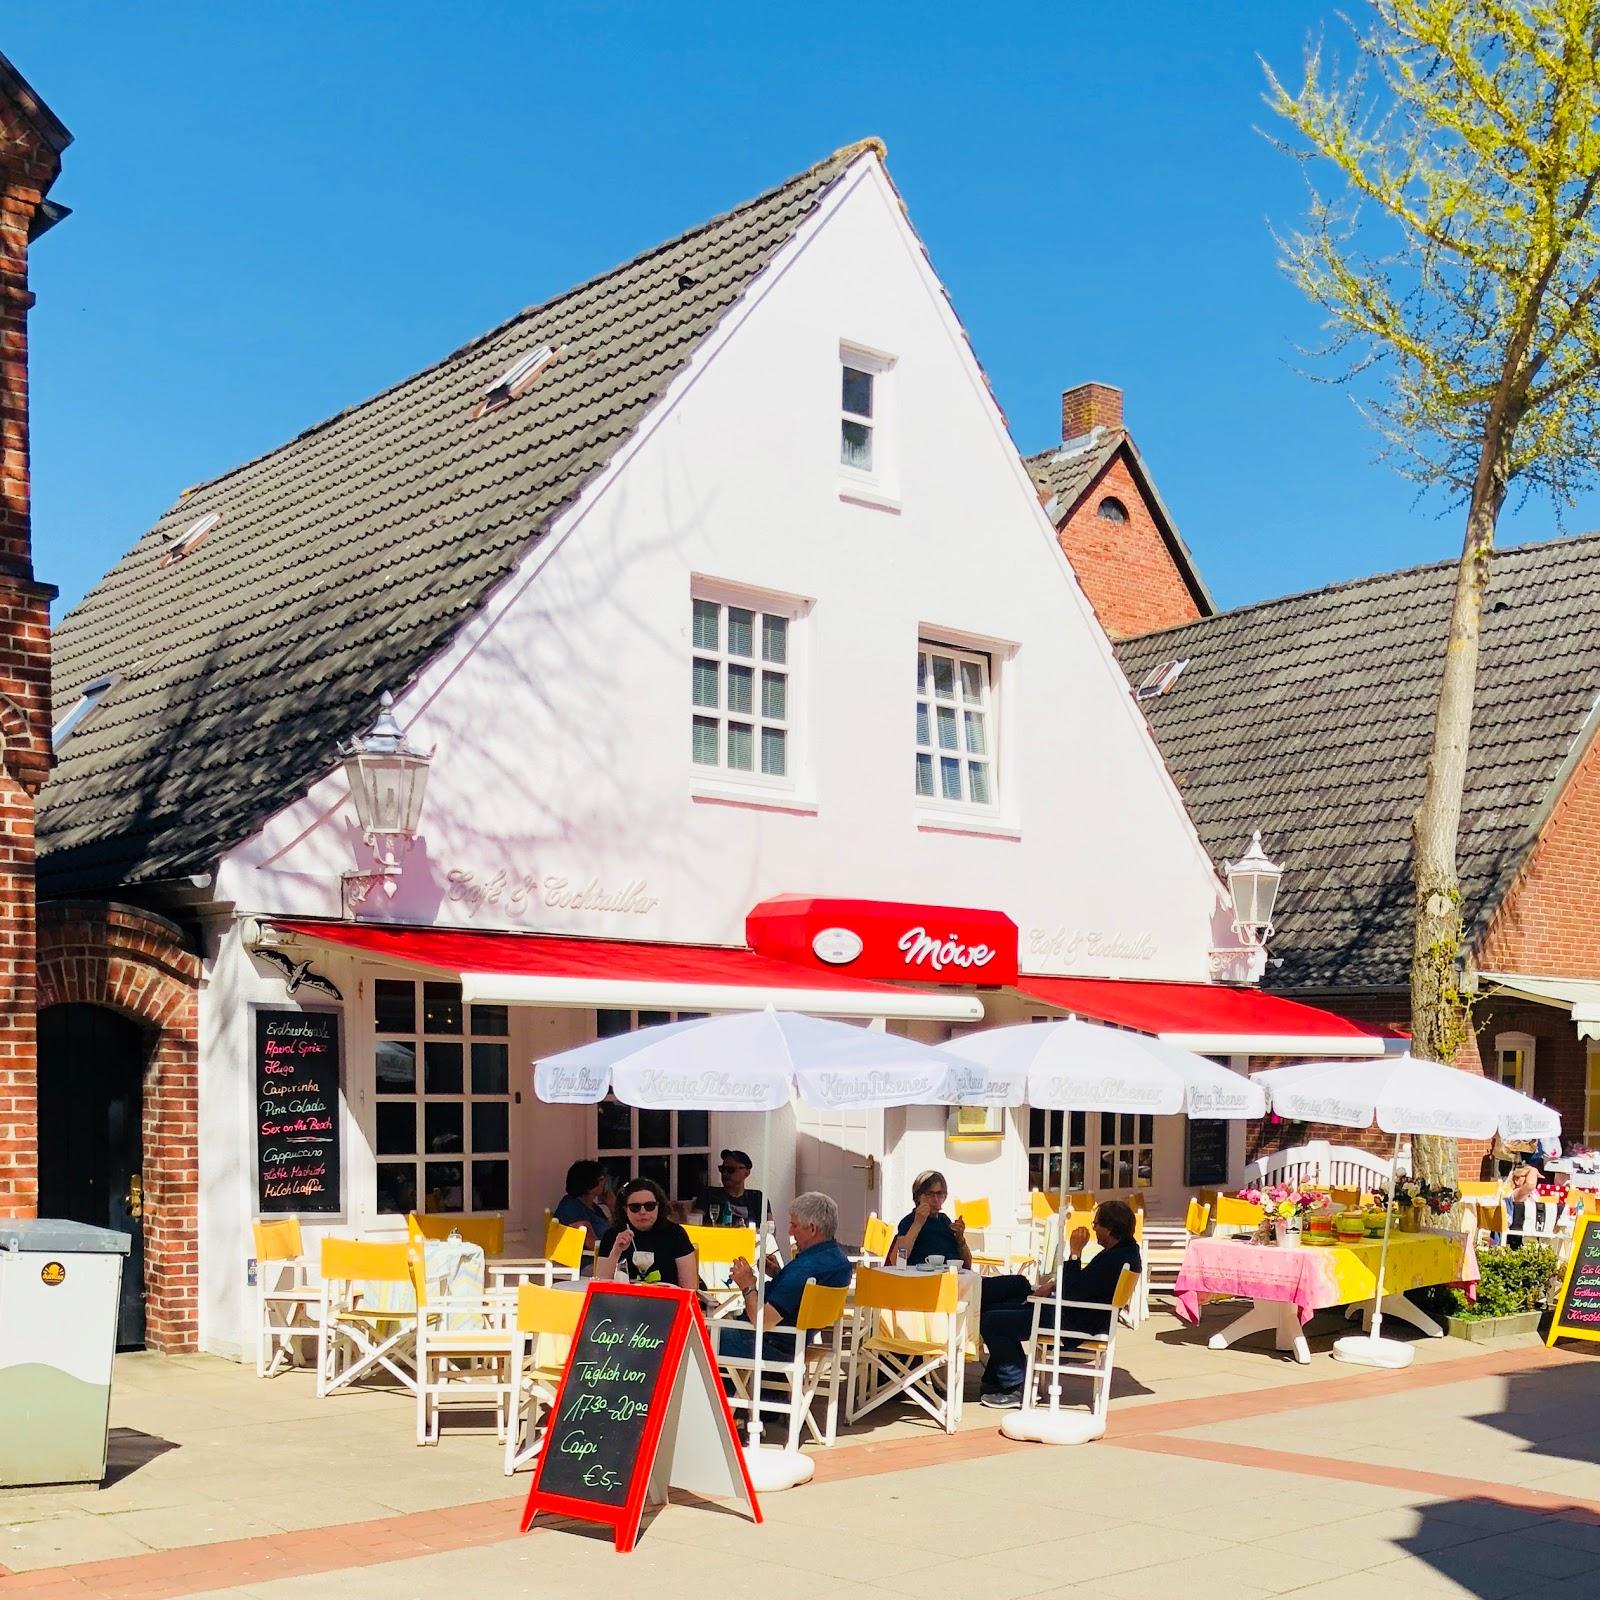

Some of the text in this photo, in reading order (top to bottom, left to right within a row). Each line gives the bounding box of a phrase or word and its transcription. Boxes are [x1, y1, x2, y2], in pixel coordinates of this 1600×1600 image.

[898, 927, 997, 972] Möwe
[264, 1060, 294, 1077] Hugo
[640, 1069, 770, 1099] König Pilsener
[288, 1098, 327, 1113] Colada
[261, 1121, 281, 1135] Sex
[294, 1119, 307, 1131] the
[306, 1116, 332, 1131] Beach
[590, 1318, 664, 1351] Caipi Hour
[576, 1356, 646, 1388] Täglich von
[560, 1430, 604, 1460] Caipi
